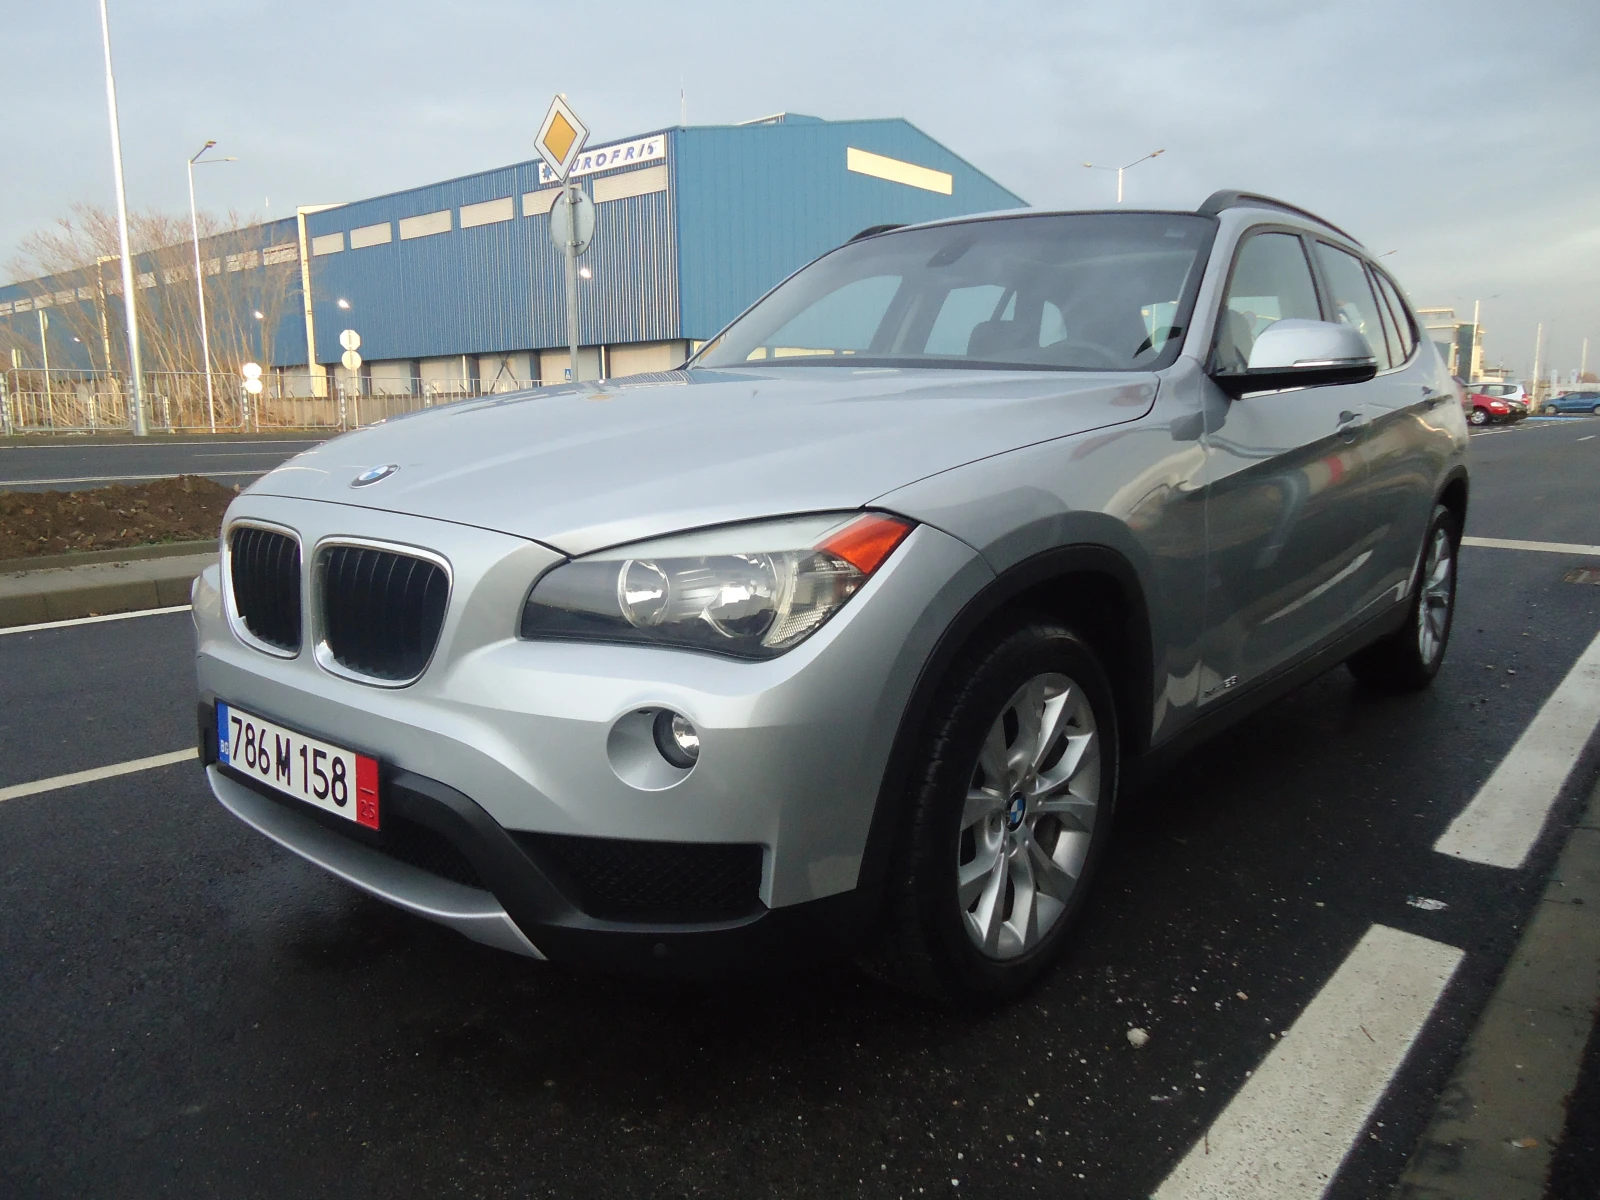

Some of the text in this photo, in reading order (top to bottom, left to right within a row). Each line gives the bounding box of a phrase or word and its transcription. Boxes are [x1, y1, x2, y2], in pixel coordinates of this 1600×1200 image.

[220, 739, 230, 755] BG
[231, 715, 348, 807] 786 M 158
